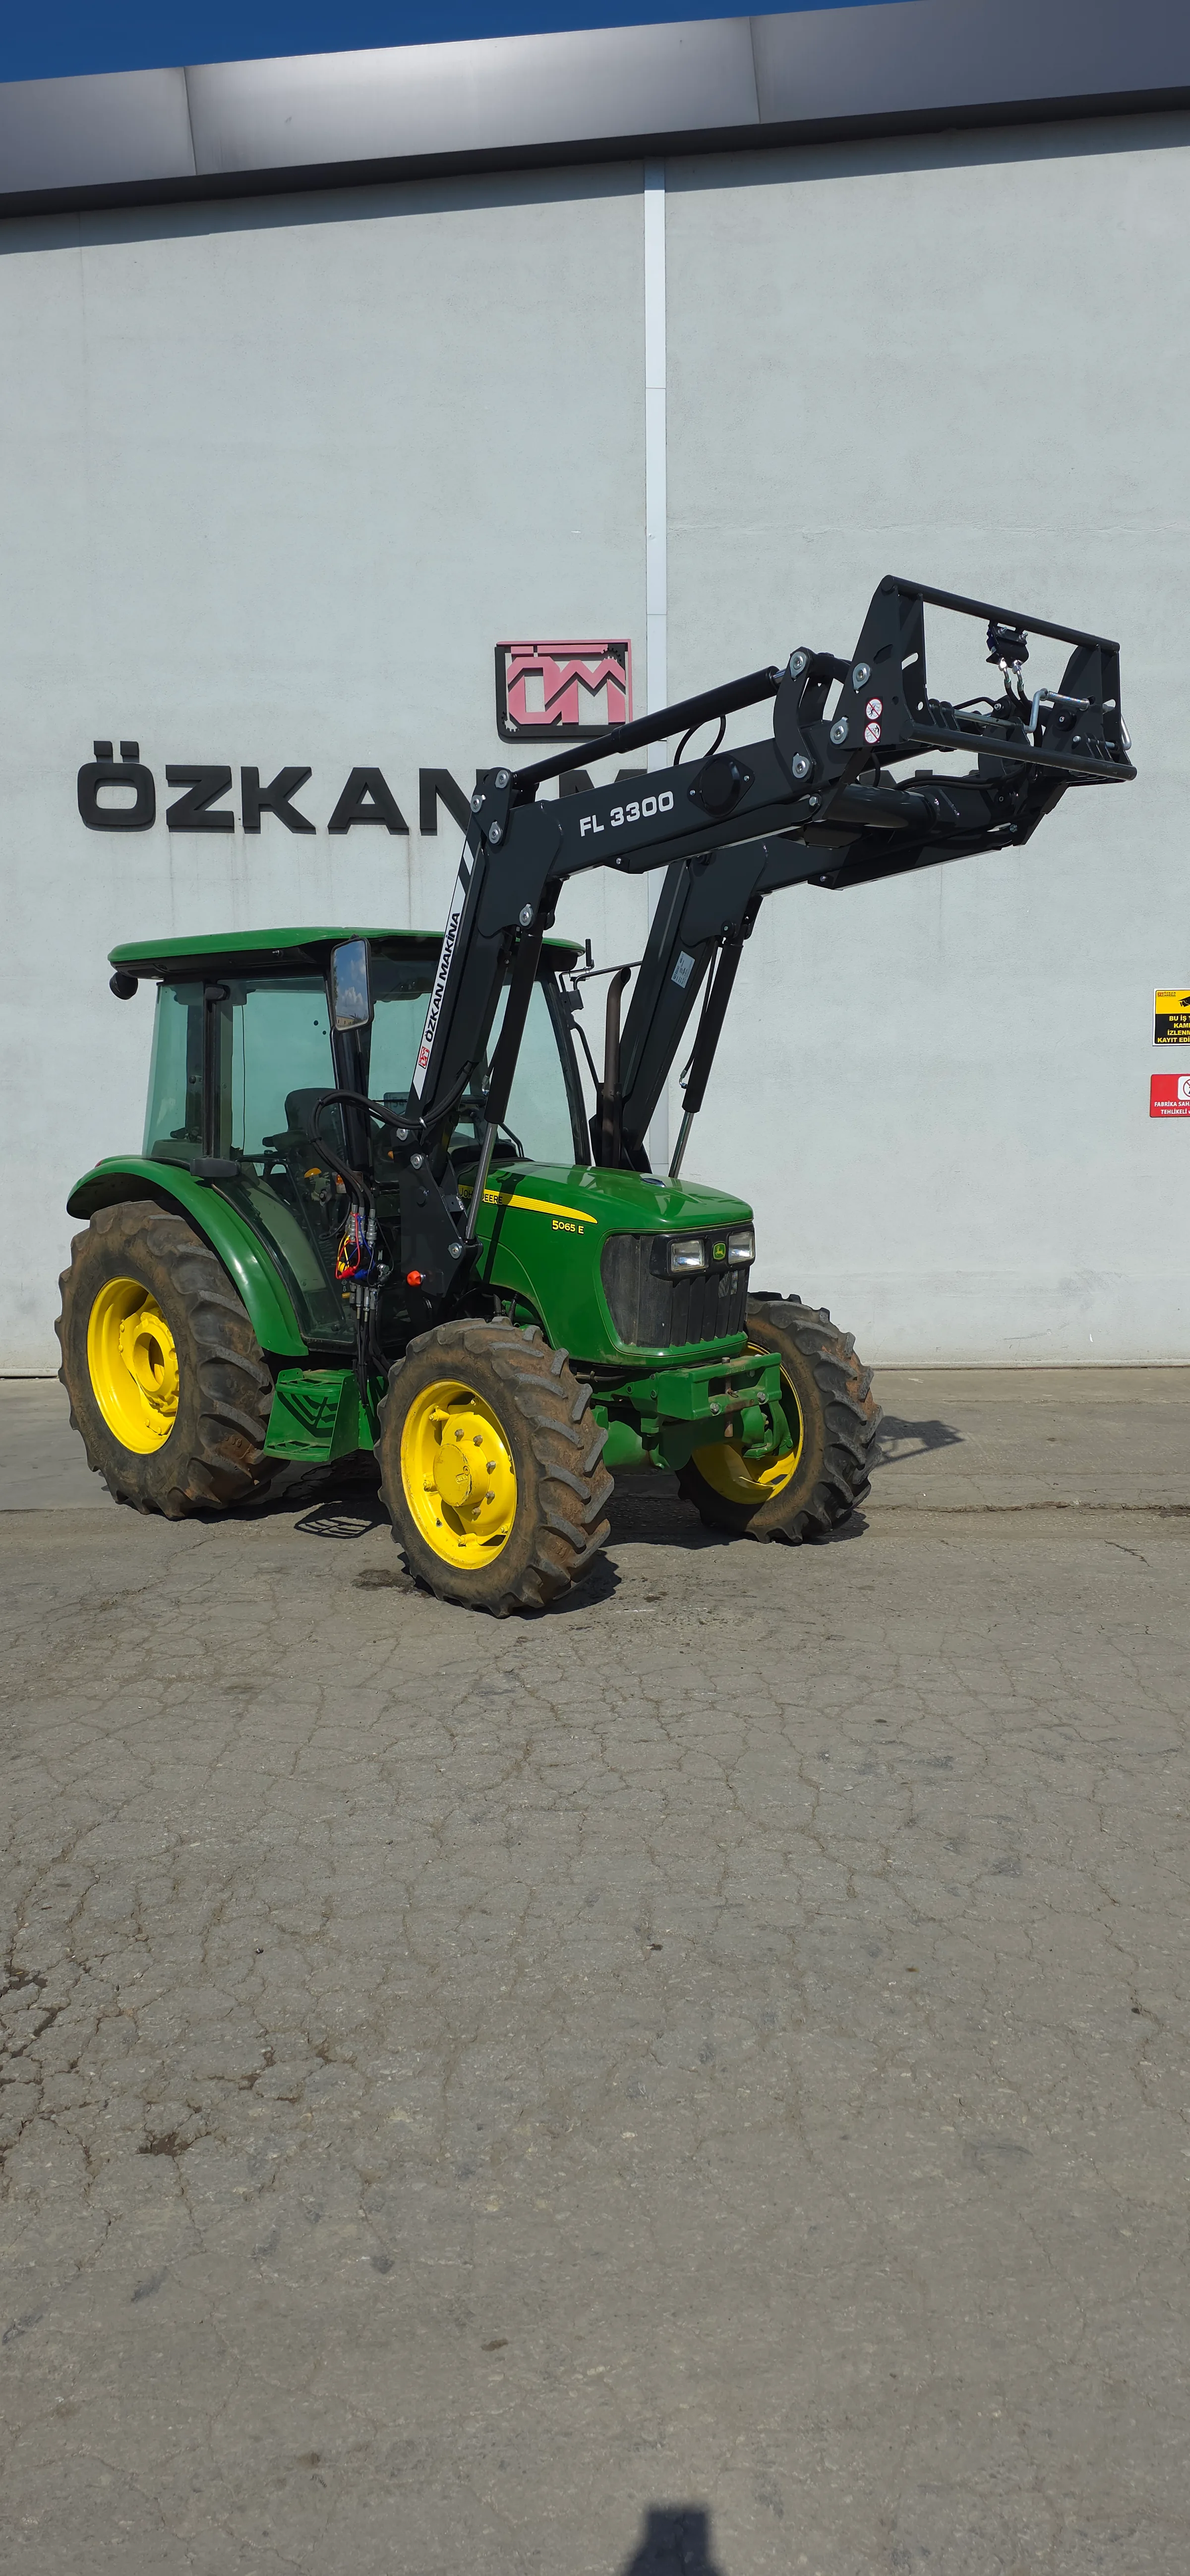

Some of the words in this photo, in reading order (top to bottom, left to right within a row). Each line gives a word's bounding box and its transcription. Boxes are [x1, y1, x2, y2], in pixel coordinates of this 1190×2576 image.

[77, 741, 488, 836] ÖZKAN
[580, 815, 604, 837] FL
[610, 791, 674, 827] 3300
[425, 983, 444, 1042] ÖZKAN
[439, 912, 460, 981] MAKİNA
[461, 1187, 474, 1198] JOH
[552, 1220, 576, 1232] 5065
[578, 1225, 584, 1234] E
